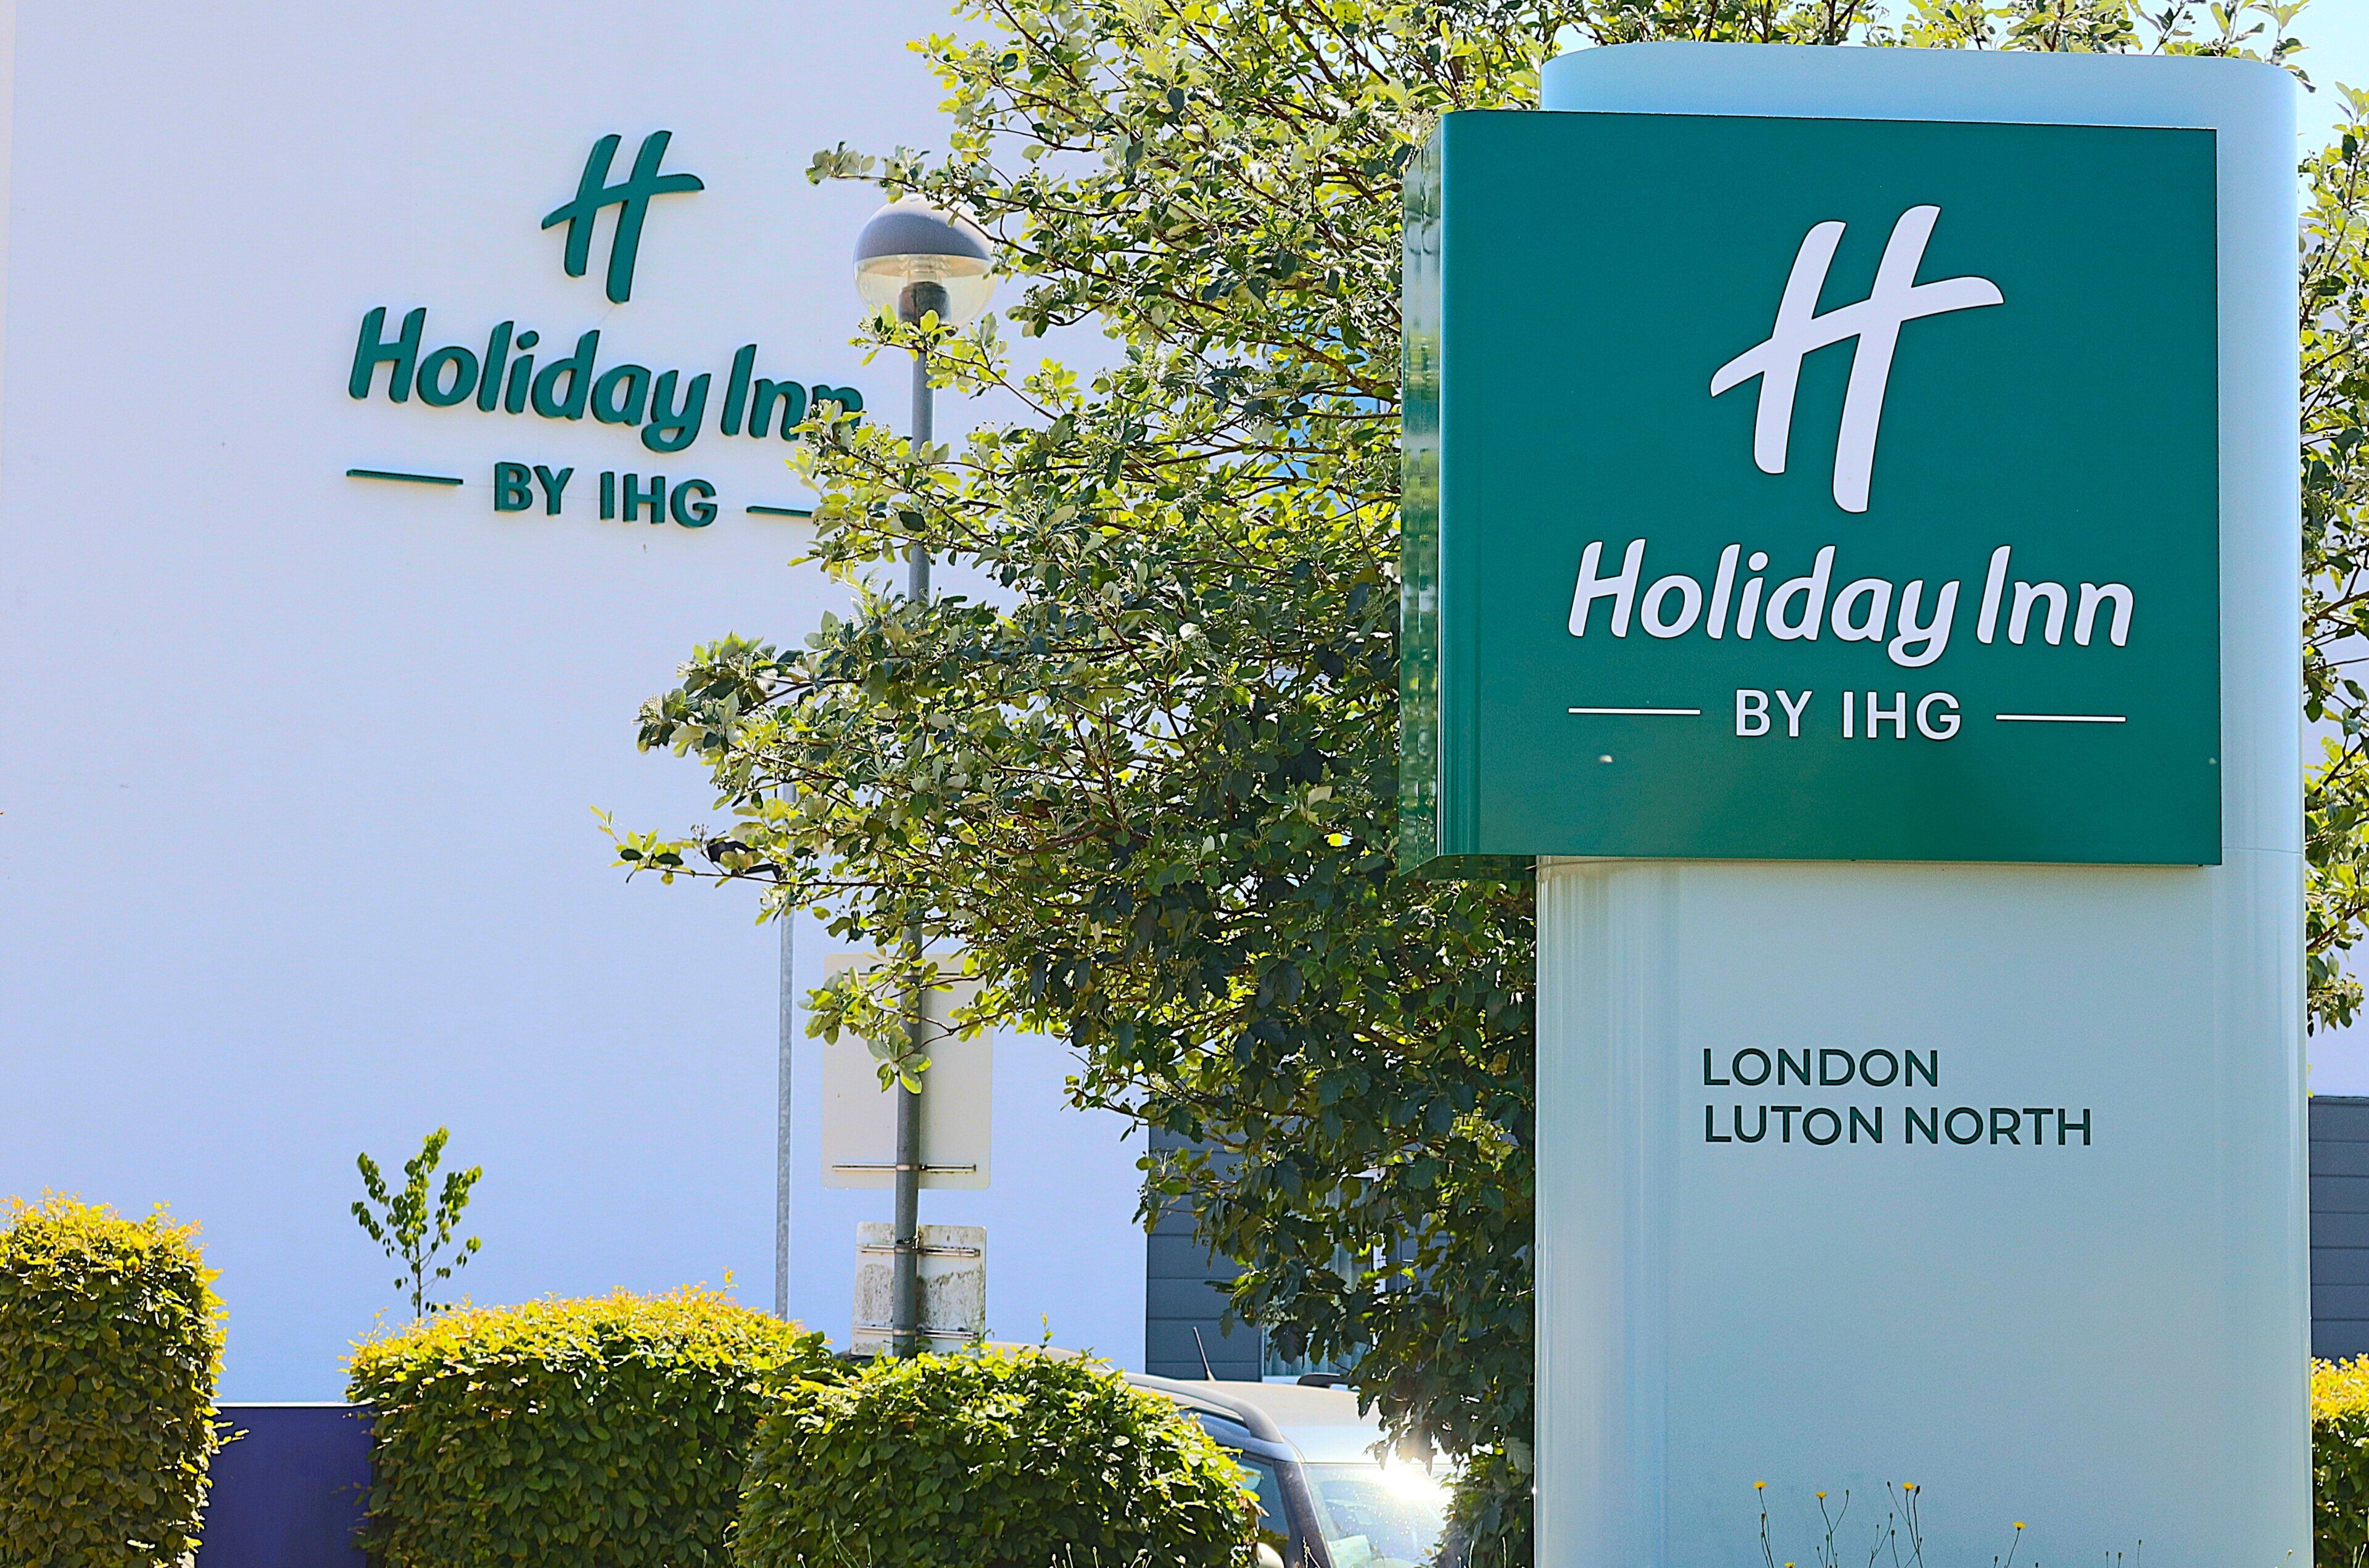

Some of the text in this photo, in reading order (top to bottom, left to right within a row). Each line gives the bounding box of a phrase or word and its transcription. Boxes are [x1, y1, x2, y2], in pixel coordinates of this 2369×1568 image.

[540, 130, 705, 305] H
[348, 306, 712, 453] Holiday
[1710, 204, 2004, 513] H
[494, 461, 718, 529] BY IHG
[1568, 538, 2134, 668] Holiday Inn
[1735, 688, 1962, 740] BY IHG
[1703, 1047, 1938, 1088] LONDON
[1705, 1104, 2091, 1147] LUTON NORTH
